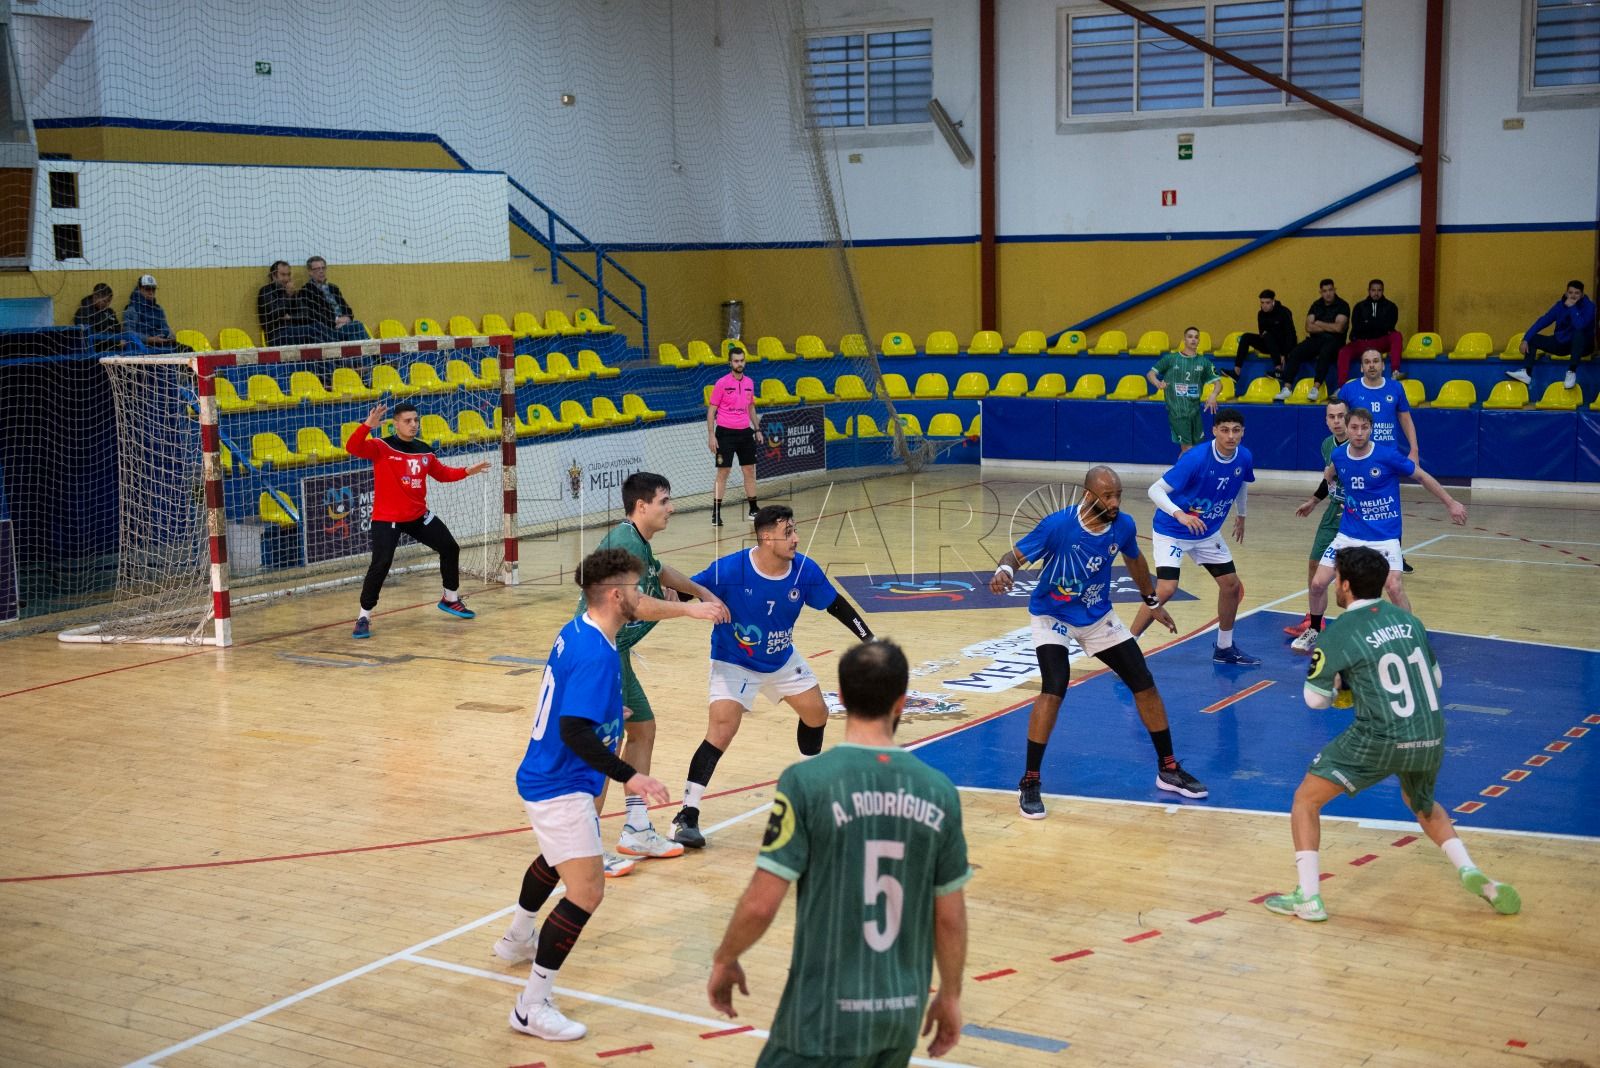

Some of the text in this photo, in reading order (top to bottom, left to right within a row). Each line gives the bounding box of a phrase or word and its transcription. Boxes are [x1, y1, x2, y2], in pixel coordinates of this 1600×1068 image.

[1185, 371, 1191, 381] 2
[1370, 401, 1381, 413] 18
[787, 424, 815, 437] MELILLA
[787, 435, 810, 447] SPORT
[787, 445, 816, 458] CAPITAL
[588, 462, 610, 471] CIUDAD
[1350, 476, 1365, 490] 26
[1360, 495, 1395, 508] MELILLA
[1361, 504, 1390, 515] SPORT
[1362, 510, 1399, 521] CAPITAL
[1169, 545, 1183, 558] 73
[1085, 555, 1103, 573] 42
[766, 600, 776, 616] 7
[1051, 621, 1068, 636] 42
[1377, 646, 1439, 718] 91
[831, 787, 945, 833] A. RODRÍGUEZ
[863, 839, 906, 953] 5
